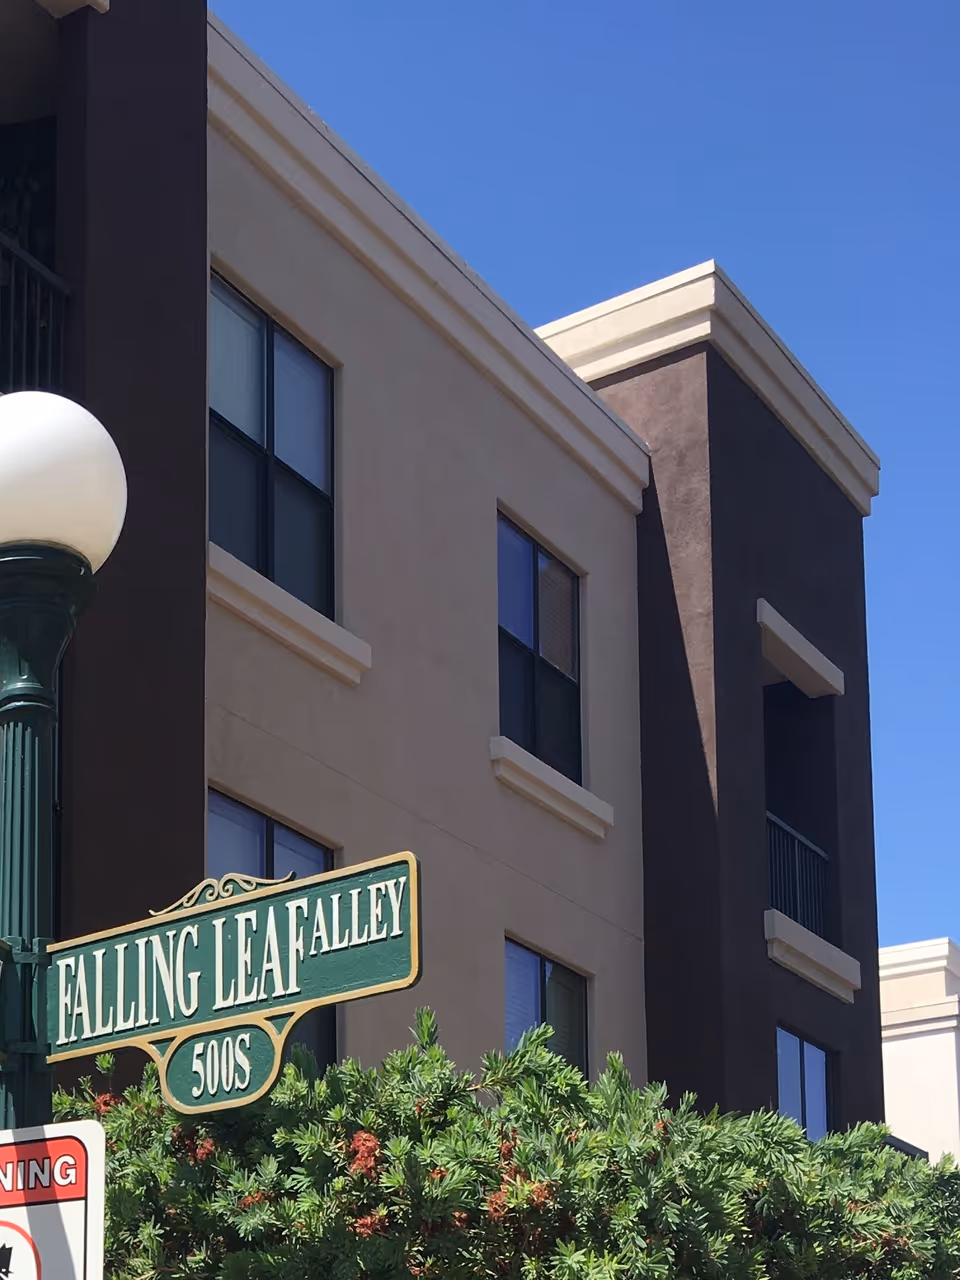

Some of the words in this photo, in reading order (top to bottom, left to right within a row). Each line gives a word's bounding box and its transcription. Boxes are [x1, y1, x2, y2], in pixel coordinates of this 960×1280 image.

[56, 924, 200, 1047] FALLING
[212, 897, 308, 1011] LEAF
[306, 875, 408, 956] ALLEY
[191, 1032, 252, 1099] 500S
